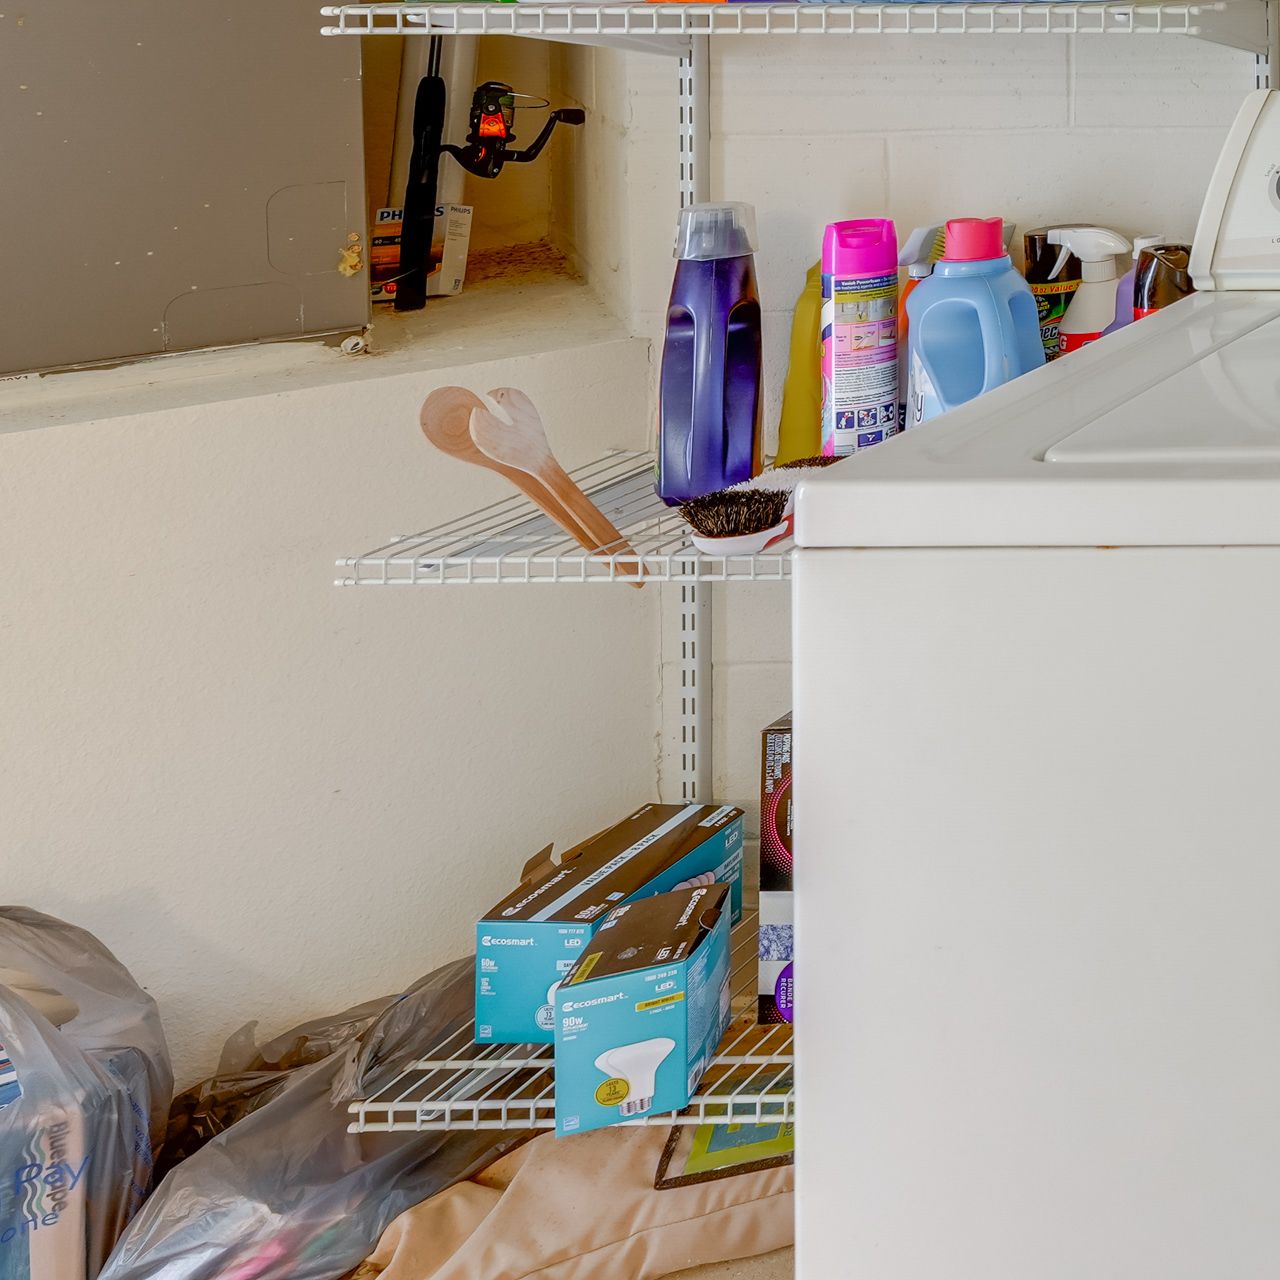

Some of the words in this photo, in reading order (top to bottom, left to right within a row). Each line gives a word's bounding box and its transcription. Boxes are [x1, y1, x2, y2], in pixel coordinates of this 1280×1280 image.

[1050, 284, 1073, 292] Value
[491, 937, 534, 946] ecosmart
[564, 938, 581, 947] LED
[655, 982, 674, 992] LED
[573, 992, 624, 1009] ecosmart
